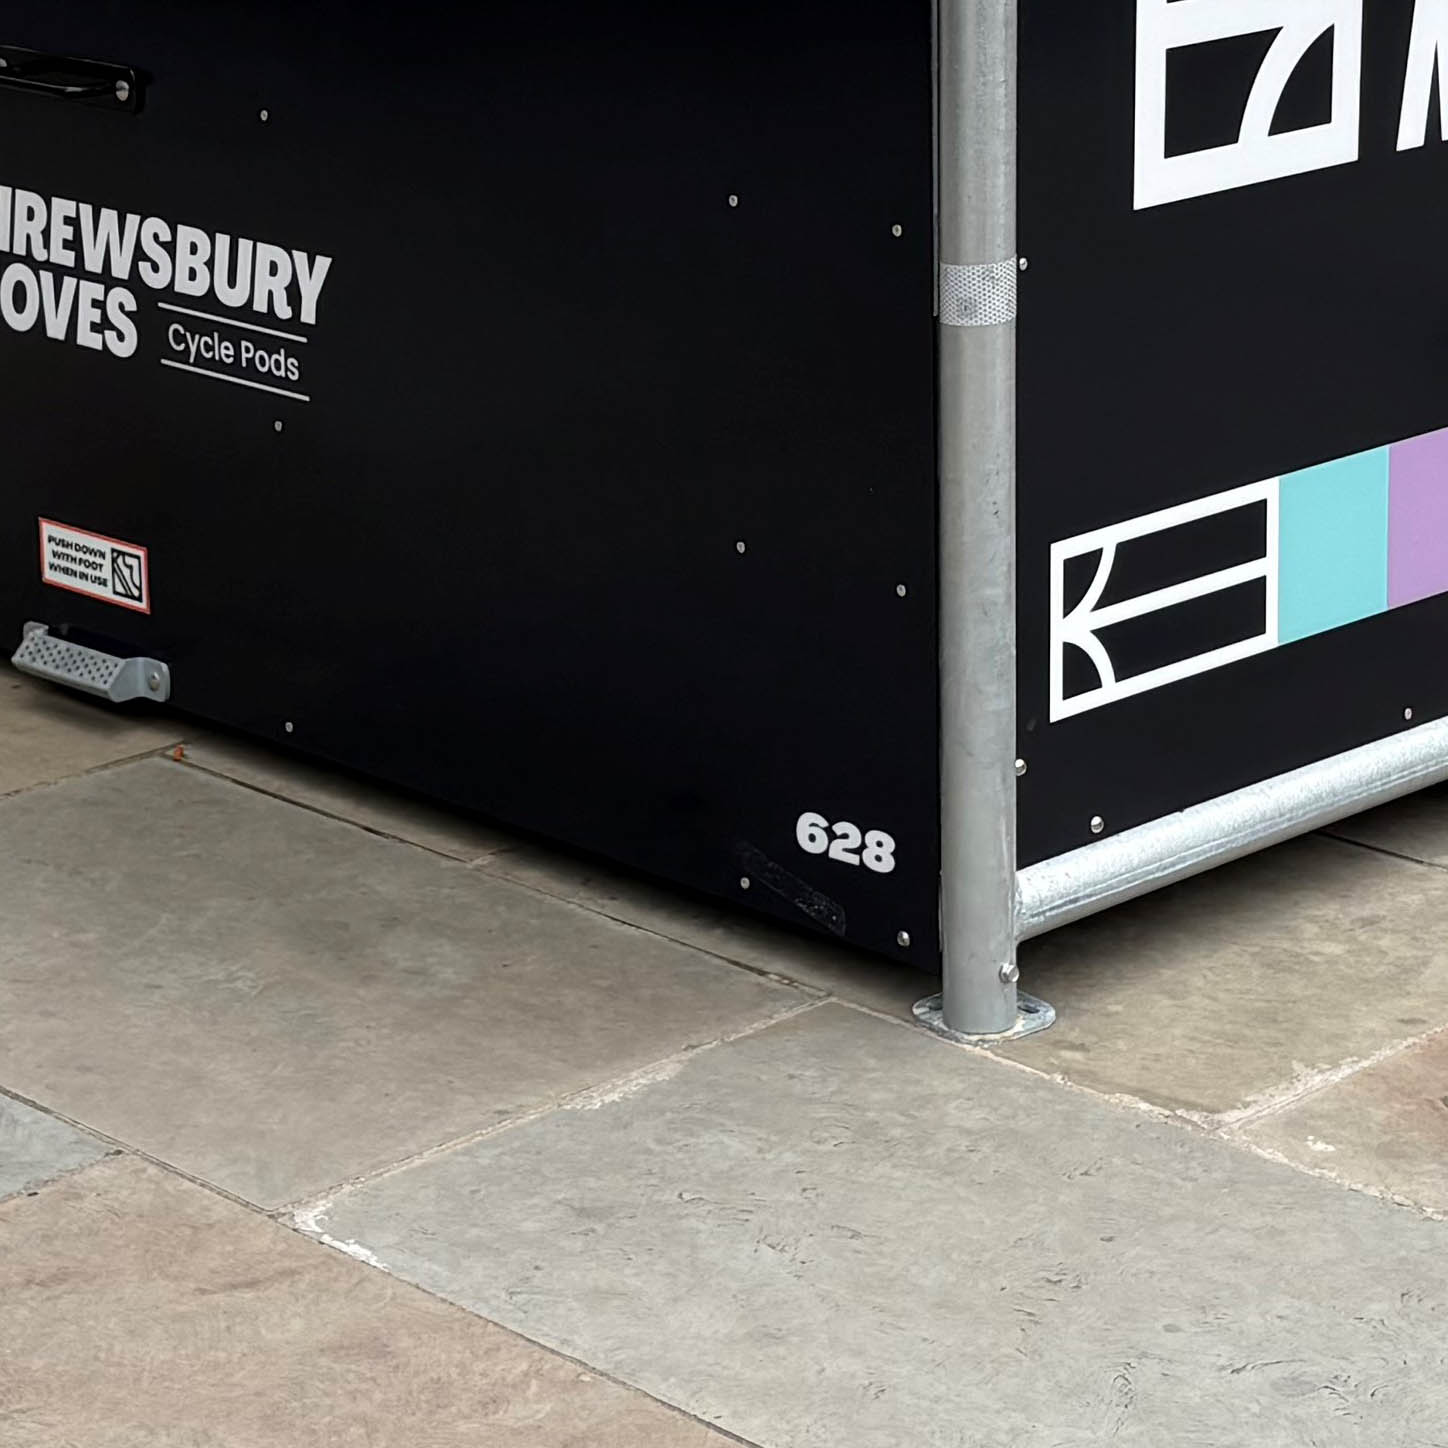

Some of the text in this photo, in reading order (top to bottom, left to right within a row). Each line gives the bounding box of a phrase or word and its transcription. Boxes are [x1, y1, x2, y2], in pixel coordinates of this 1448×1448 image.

[167, 323, 300, 381] Cycle Pods
[47, 535, 106, 560] PUSH DOWN
[51, 549, 104, 573] WITH FOOT
[48, 561, 109, 588] WHEN IN USE
[796, 811, 896, 873] 628
